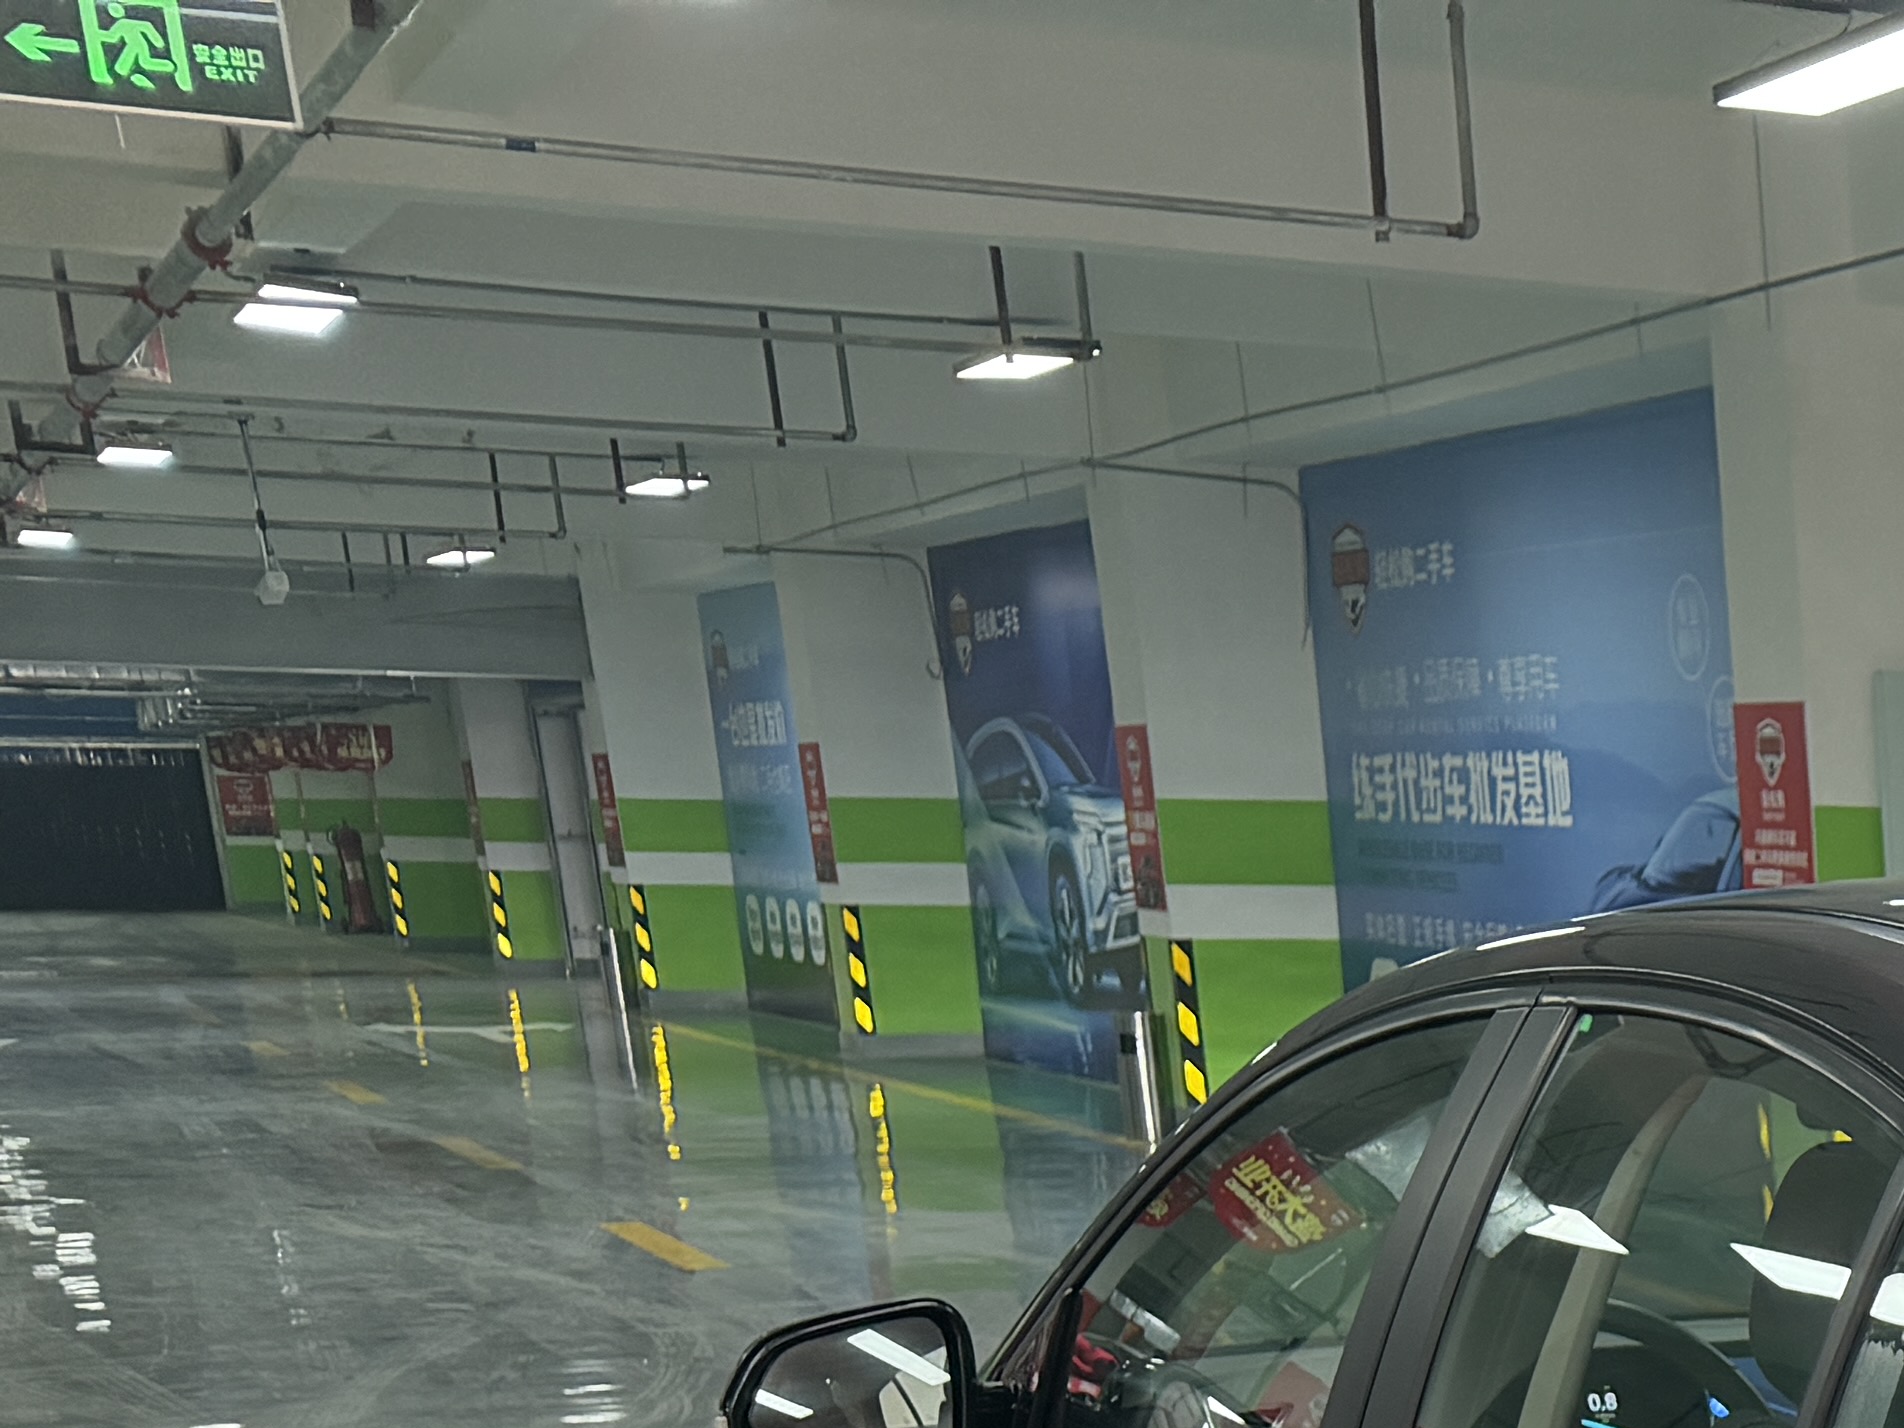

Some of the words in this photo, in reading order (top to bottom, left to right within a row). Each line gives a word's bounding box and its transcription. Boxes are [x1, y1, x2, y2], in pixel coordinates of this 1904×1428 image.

[191, 43, 265, 70] 安全出口
[204, 65, 258, 84] EXIT
[1352, 749, 1574, 828] 练手代步车批发基地
[1587, 1391, 1618, 1412] 0.8
